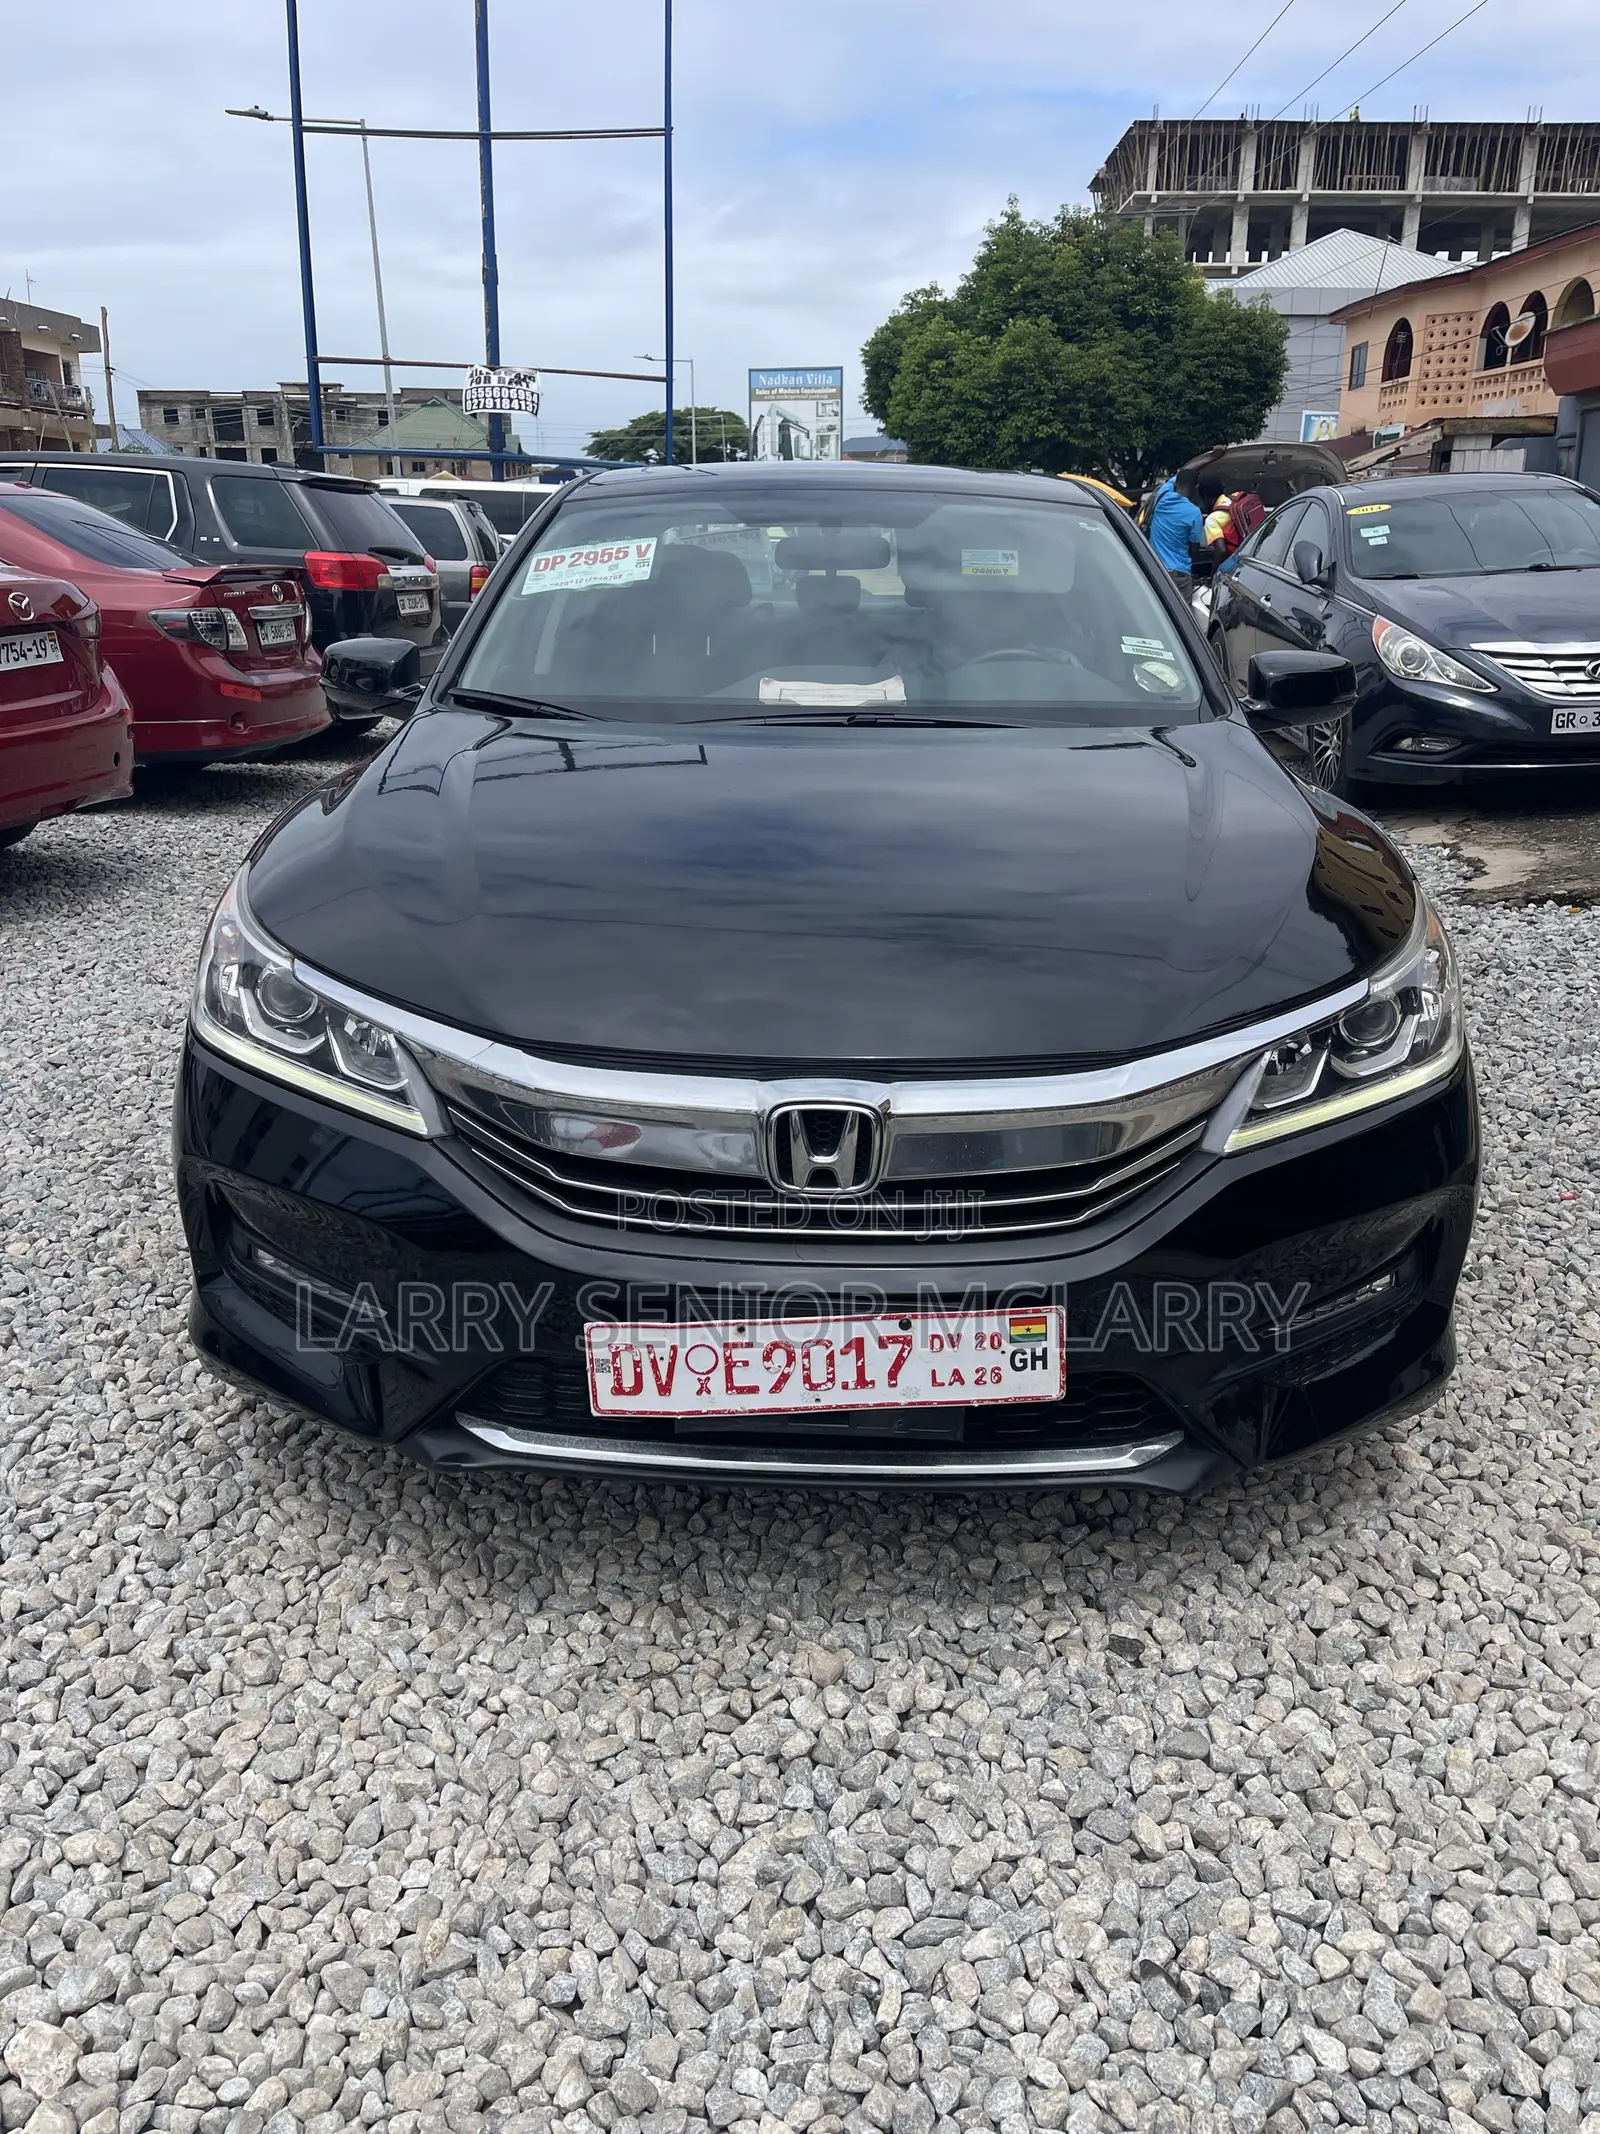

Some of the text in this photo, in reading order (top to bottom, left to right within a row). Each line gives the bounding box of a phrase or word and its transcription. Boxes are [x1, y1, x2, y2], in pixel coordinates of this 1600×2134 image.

[759, 373, 833, 386] Nadkan Villa
[466, 387, 538, 404] 0555606954
[466, 398, 538, 414] 0279184137
[533, 543, 652, 573] DP 2955 V
[0, 638, 48, 665] 754-19
[1555, 712, 1576, 729] GR
[928, 1331, 1003, 1353] DV 20
[607, 1333, 913, 1397] DV E9017
[1009, 1347, 1049, 1372] GH
[930, 1366, 1003, 1388] LA 26
